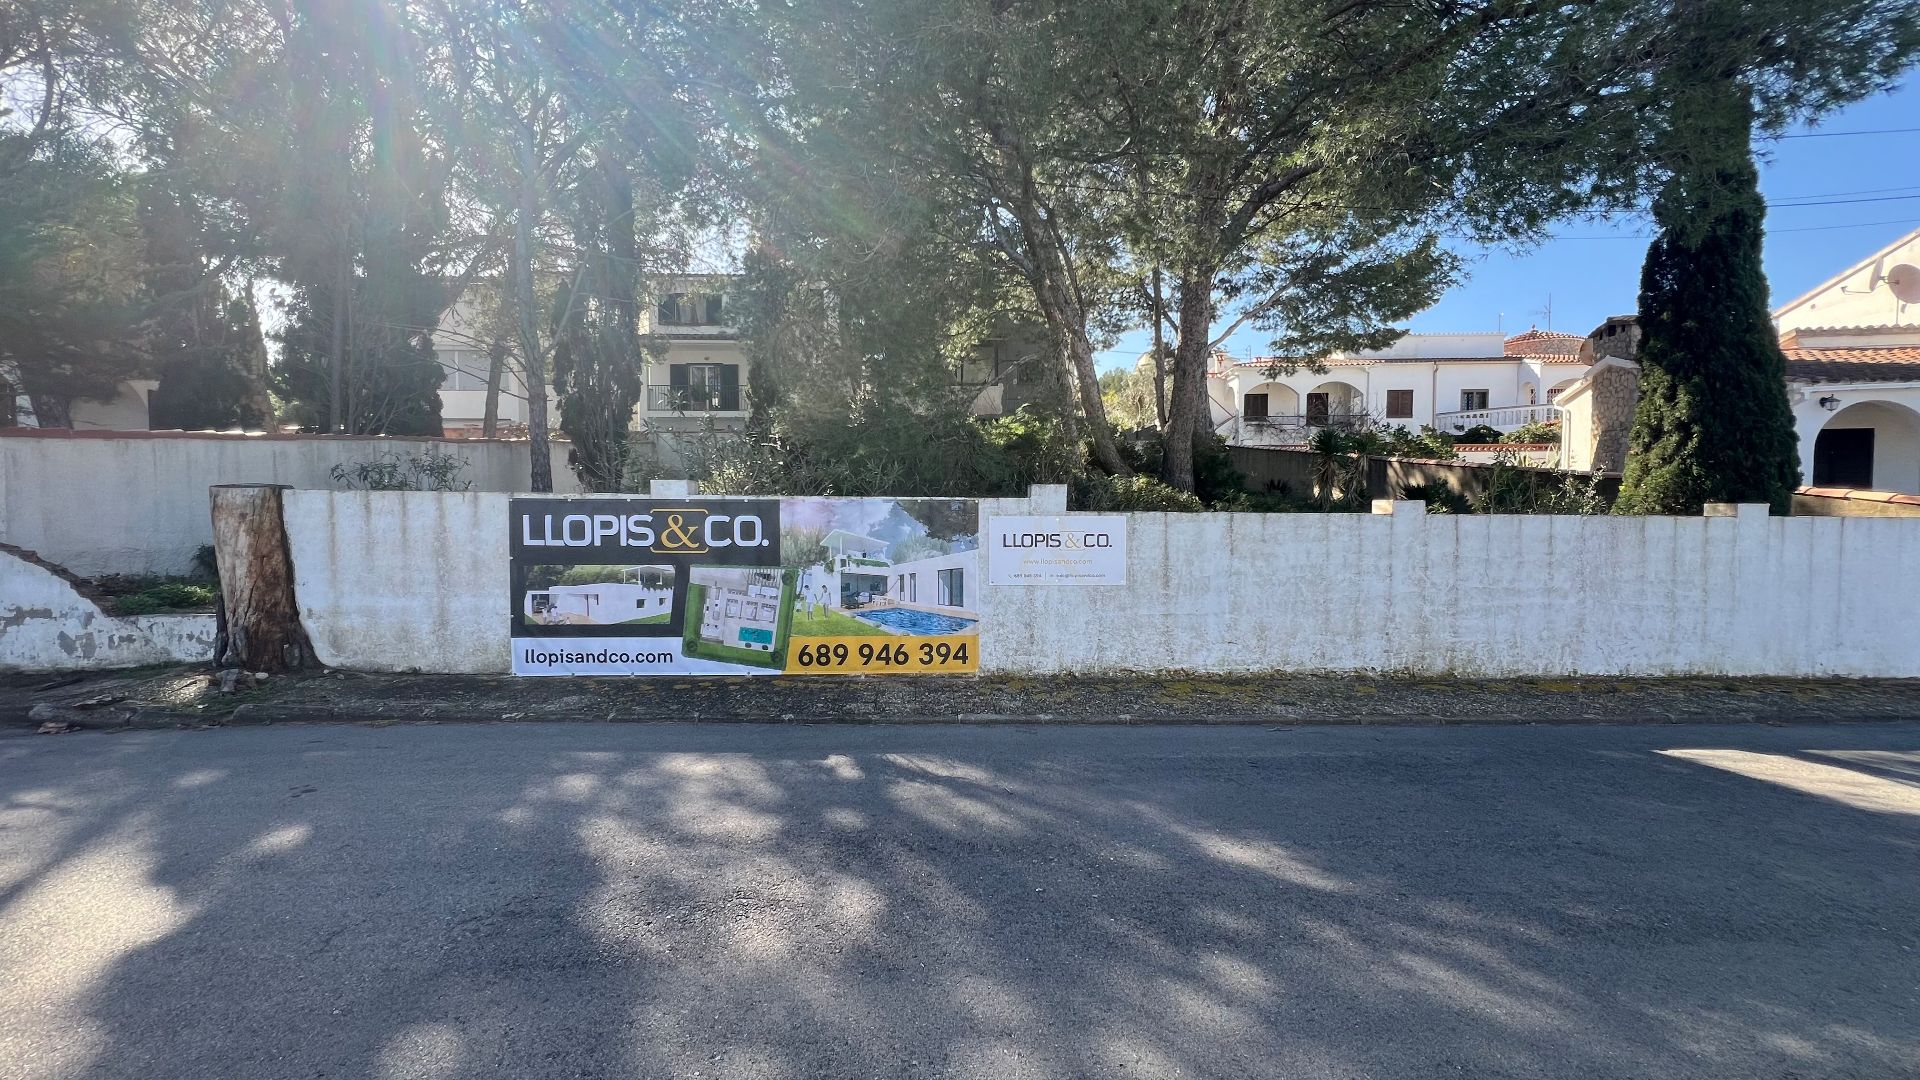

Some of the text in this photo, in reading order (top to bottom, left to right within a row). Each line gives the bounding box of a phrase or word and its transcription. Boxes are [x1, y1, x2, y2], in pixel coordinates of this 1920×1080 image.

[522, 513, 770, 549] LLOPIS & CO.
[1002, 532, 1113, 549] LLOPIS & CO.
[524, 648, 673, 667] llopisandco.com
[798, 642, 968, 667] 689 946 394
